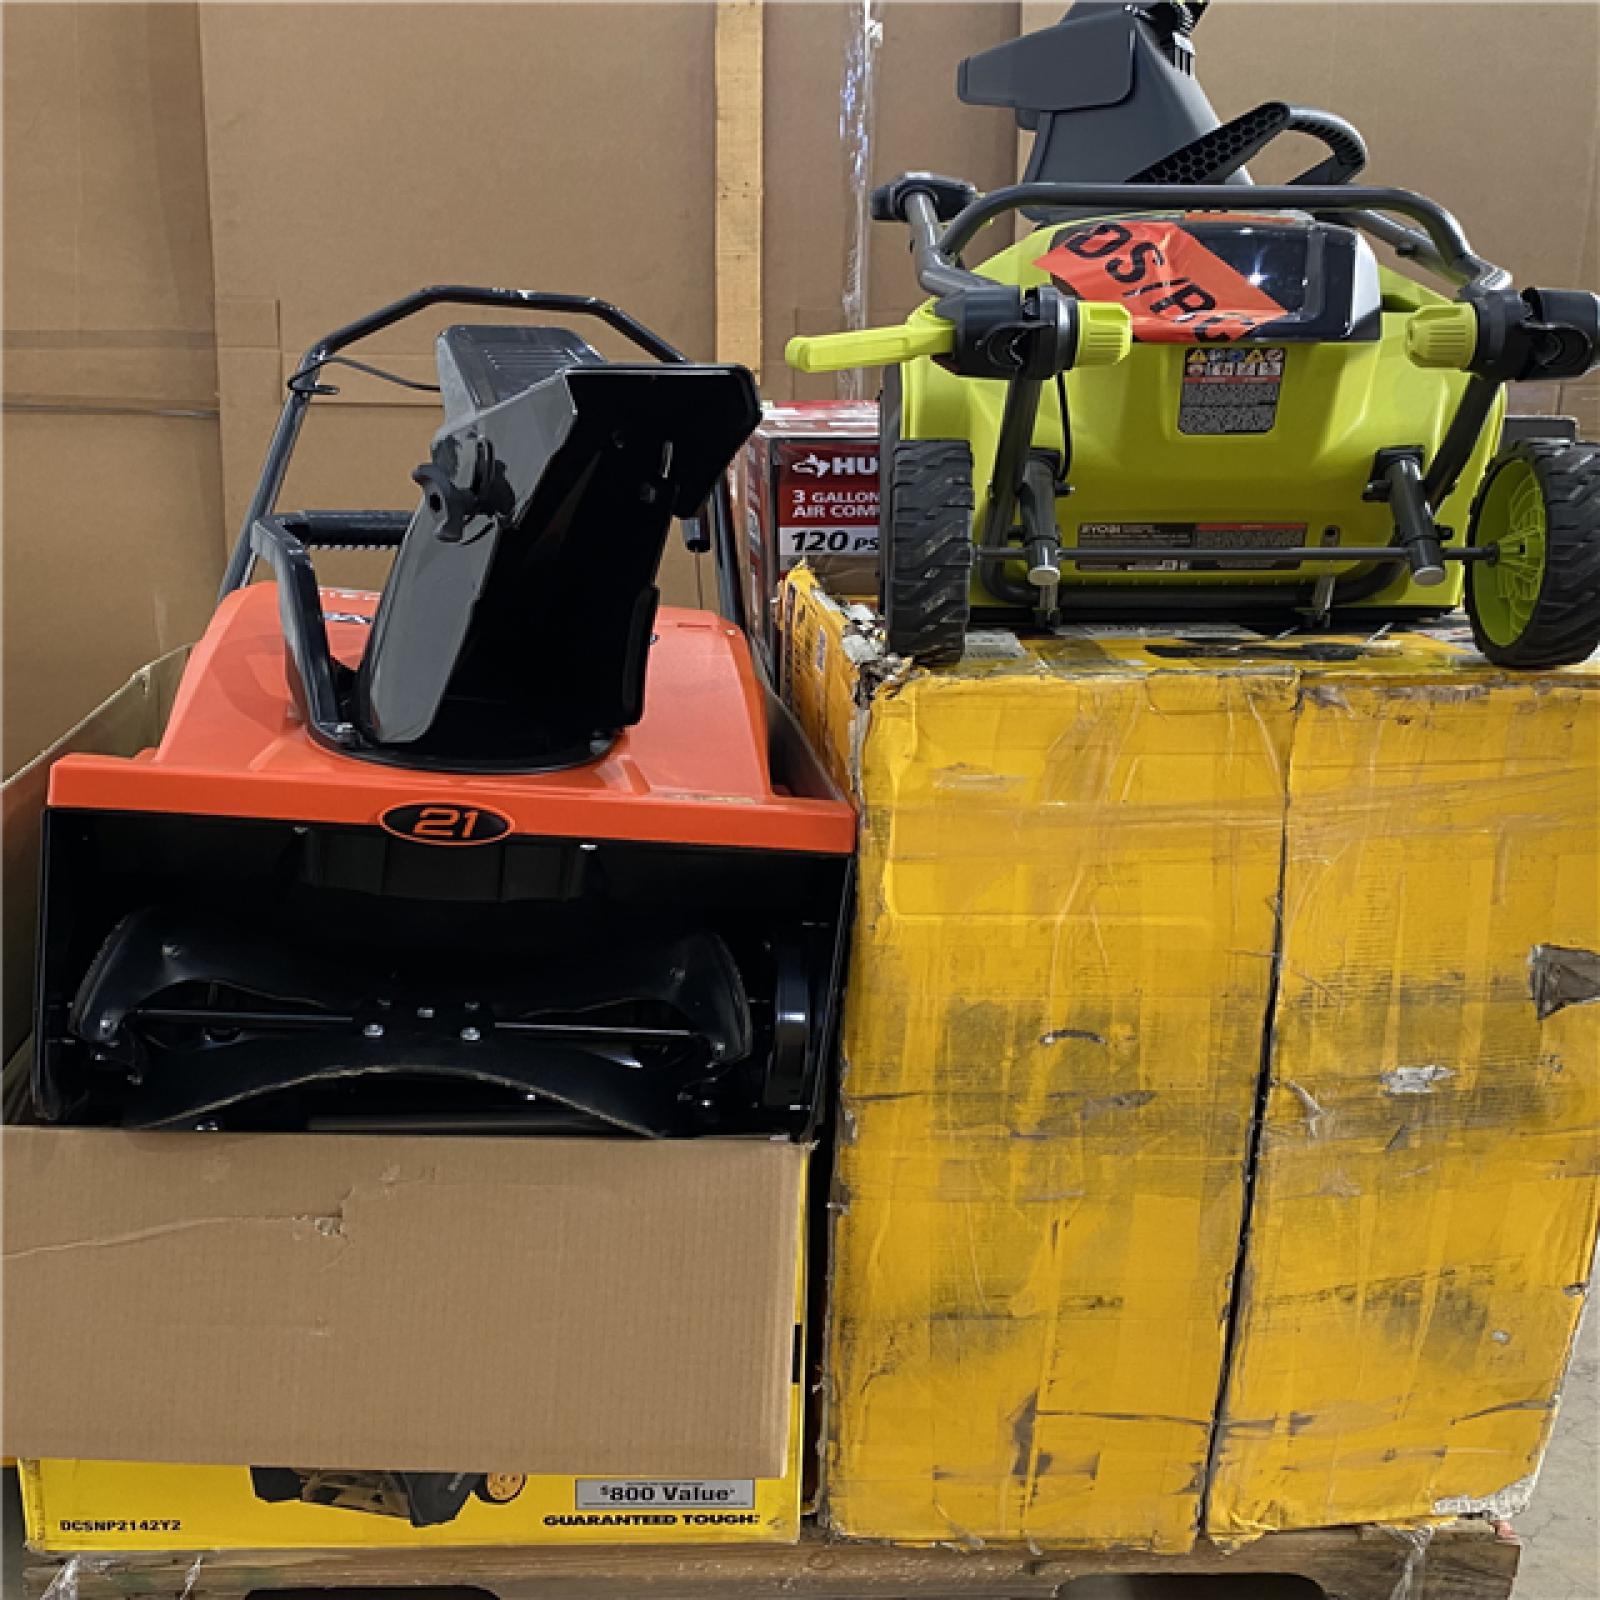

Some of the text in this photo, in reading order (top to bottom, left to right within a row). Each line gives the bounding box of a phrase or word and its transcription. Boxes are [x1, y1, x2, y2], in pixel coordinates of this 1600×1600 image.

[792, 489, 806, 504] 3
[792, 504, 826, 519] AIR
[792, 530, 849, 552] 120
[414, 807, 479, 838] 21
[543, 1514, 678, 1527] GUARANTEED
